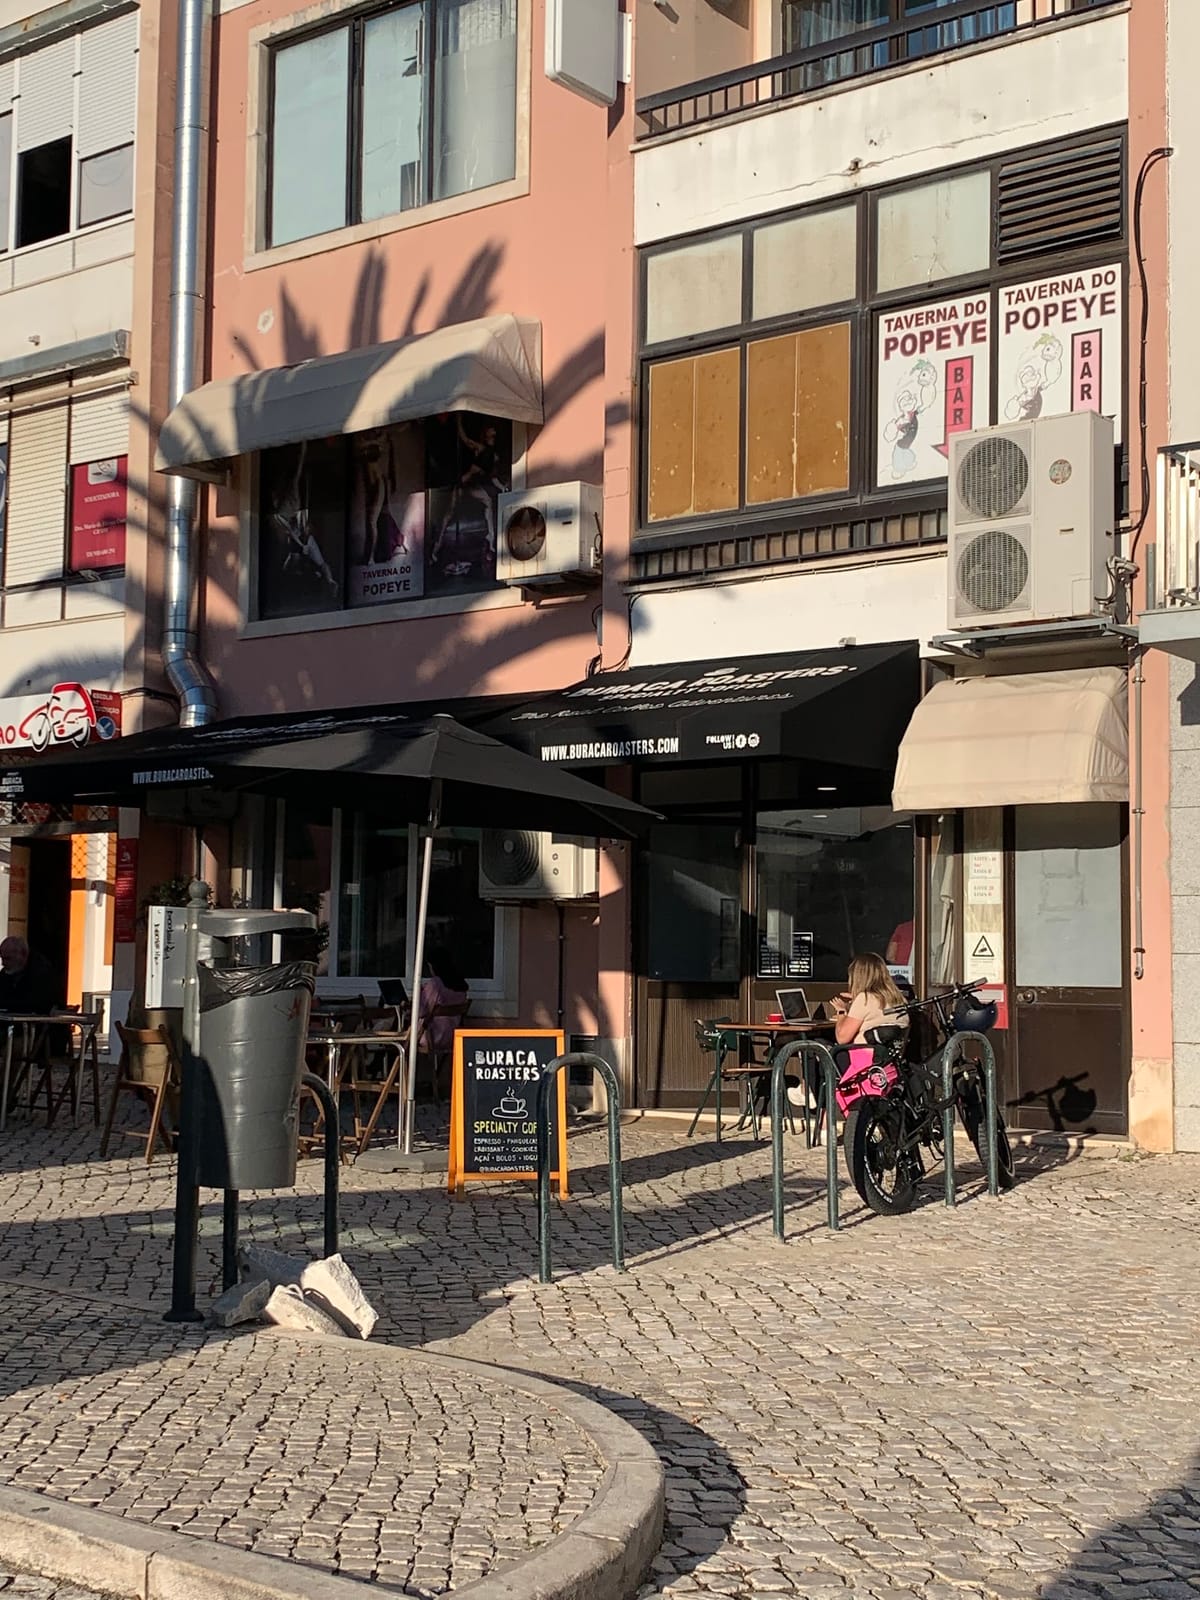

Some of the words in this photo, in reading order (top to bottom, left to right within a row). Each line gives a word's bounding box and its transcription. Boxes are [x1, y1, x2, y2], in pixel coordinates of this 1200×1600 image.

[1005, 276, 1086, 305] TAVERNA
[1091, 270, 1116, 289] DO
[884, 305, 958, 333] TAVERNA
[964, 300, 987, 318] DO
[1004, 291, 1117, 334] POPEYE
[883, 319, 988, 360] POPEYE
[1079, 340, 1093, 402] BAR
[953, 366, 964, 425] BAR
[362, 568, 398, 578] TAVERNA
[400, 566, 411, 574] DO
[363, 580, 411, 596] POPEYE
[567, 680, 688, 698] BURACA
[687, 665, 849, 688] ROASTERS
[541, 737, 679, 761] WWW.BURACAROASTERS.COM
[706, 735, 732, 744] FOLLOW
[723, 741, 732, 749] US
[475, 1051, 537, 1066] BURACA
[476, 1067, 540, 1081] ROASTERS
[474, 1121, 518, 1134] SPECIALTY
